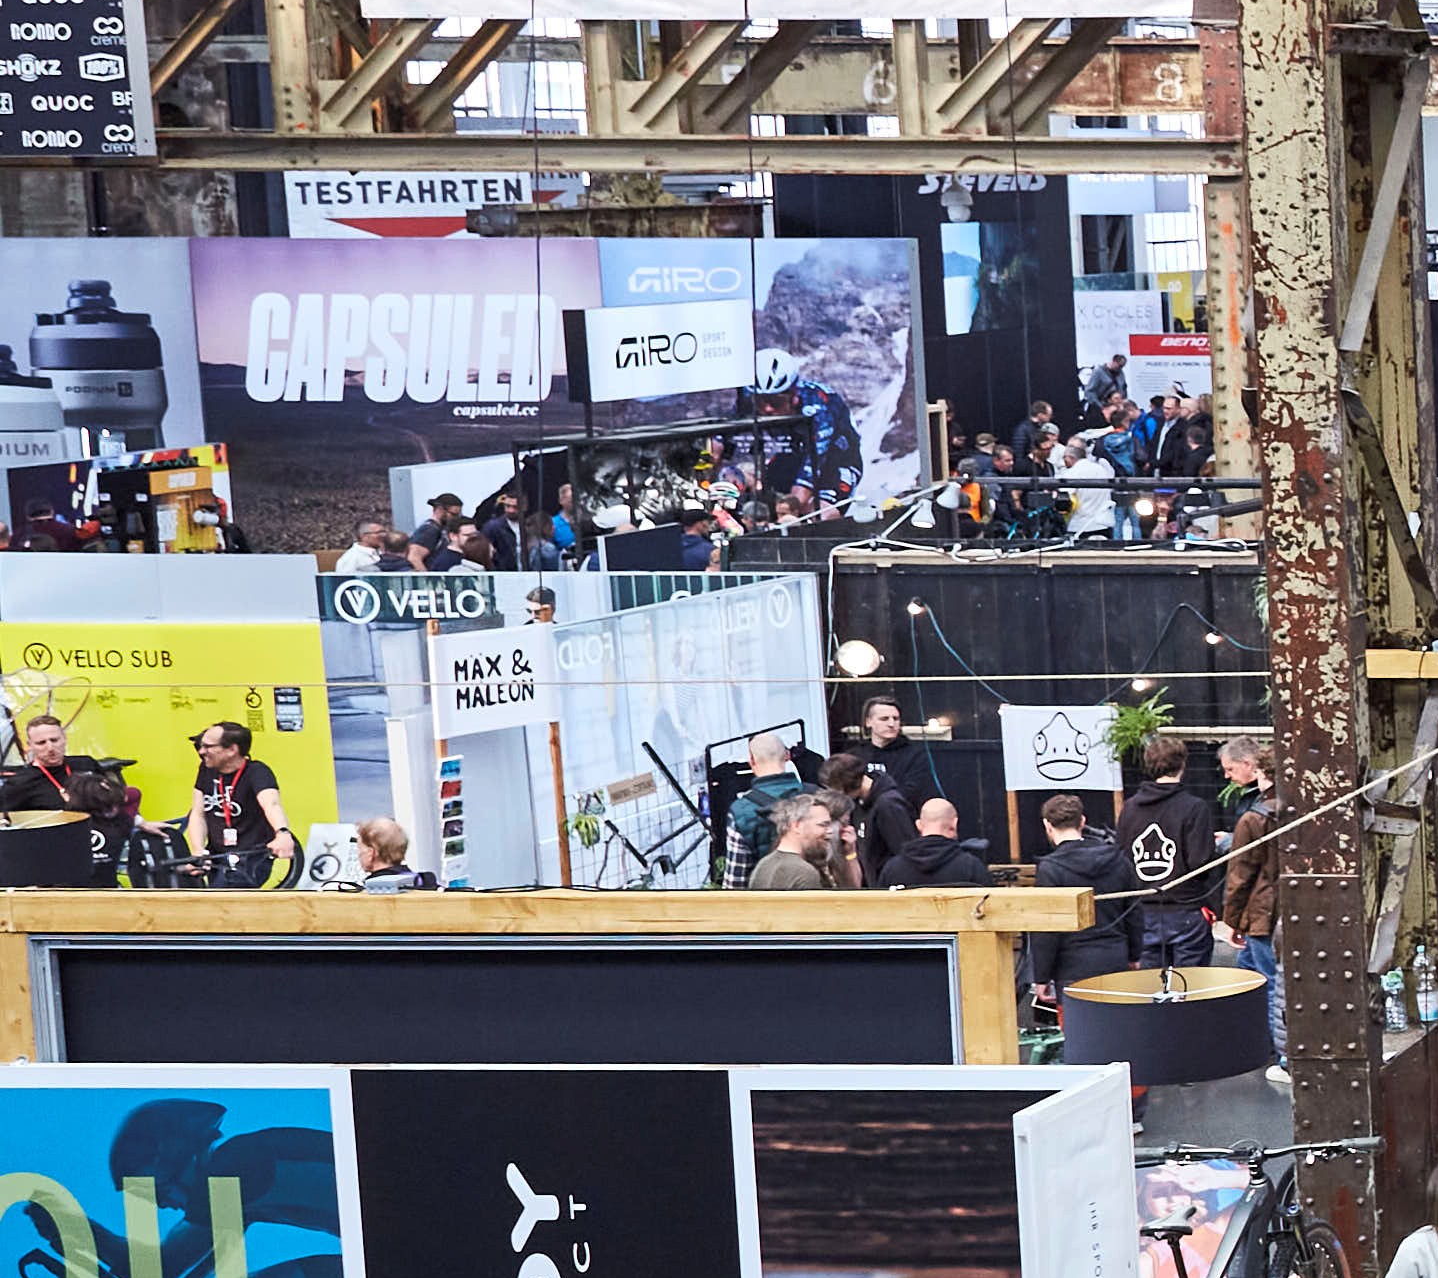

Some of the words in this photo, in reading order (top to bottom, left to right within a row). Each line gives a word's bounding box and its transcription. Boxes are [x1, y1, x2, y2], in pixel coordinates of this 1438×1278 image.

[32, 95, 95, 111] QUOC
[295, 178, 524, 206] TESTFAHRTEN
[246, 292, 553, 404] CAPSULED
[453, 403, 541, 419] capsuled.cc
[388, 589, 487, 620] VELLO
[58, 650, 123, 668] VELLO
[131, 650, 173, 668] SUB
[511, 649, 533, 675] &
